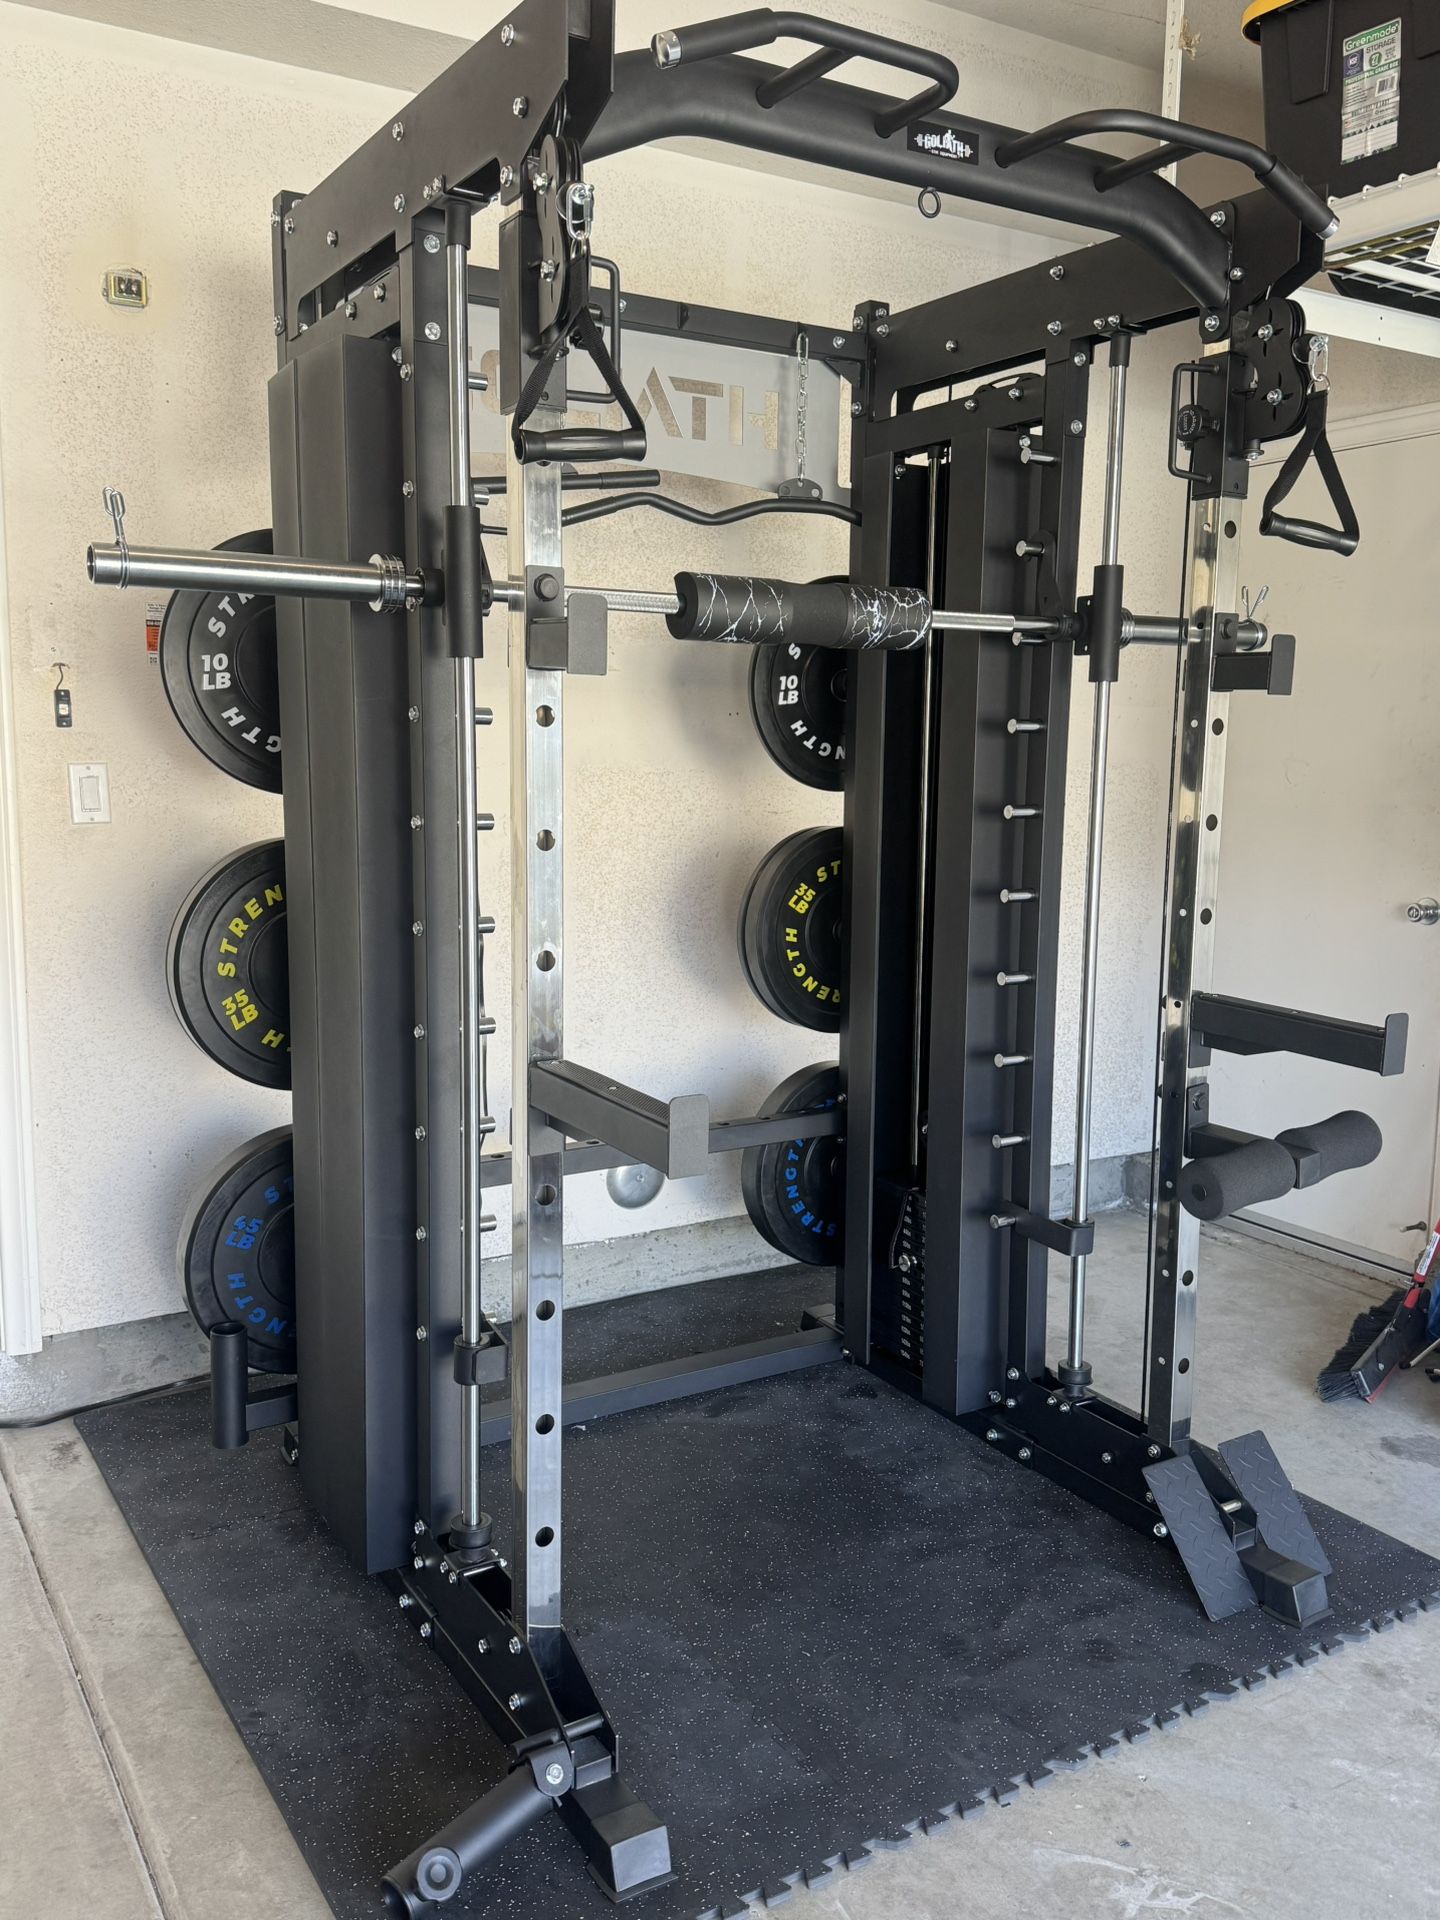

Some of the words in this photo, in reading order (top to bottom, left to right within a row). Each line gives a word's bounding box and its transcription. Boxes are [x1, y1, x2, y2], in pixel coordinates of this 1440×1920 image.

[1346, 24, 1397, 50] Greenmade
[1366, 37, 1396, 53] STORAGE
[924, 130, 964, 158] GOLIATH
[202, 653, 229, 672] 10
[202, 672, 232, 691] LB
[779, 675, 799, 691] 10
[778, 690, 799, 706] LB
[795, 882, 817, 902] 35
[787, 895, 810, 915] LB
[221, 988, 249, 1016] 35
[230, 1003, 259, 1031] LB
[233, 1215, 264, 1234] 45
[225, 1231, 256, 1250] LB
